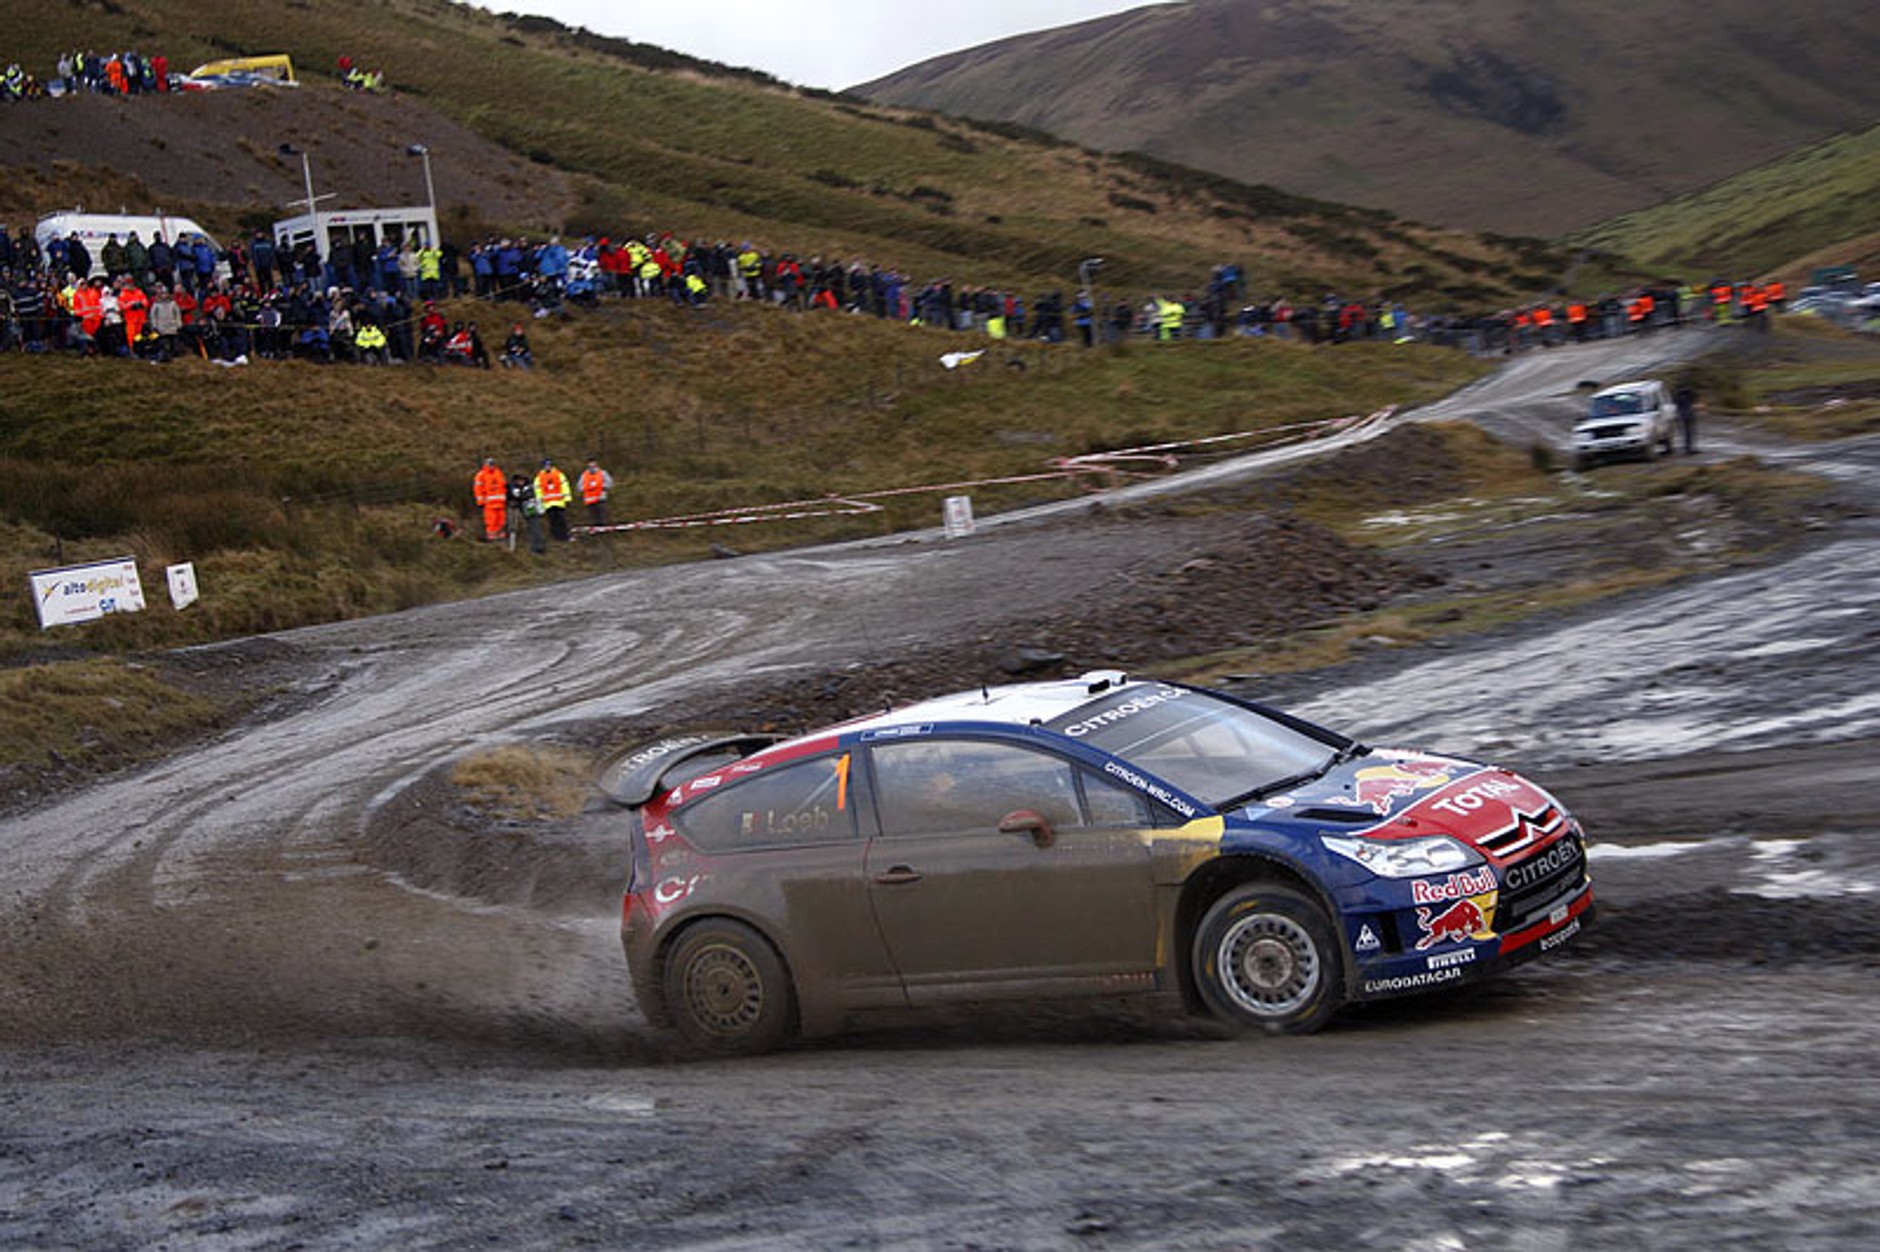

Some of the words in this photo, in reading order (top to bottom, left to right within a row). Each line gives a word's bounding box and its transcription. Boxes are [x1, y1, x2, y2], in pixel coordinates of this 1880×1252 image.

[834, 752, 851, 811] 1
[1431, 779, 1521, 816] TOTAL
[1506, 837, 1579, 889] CITROËN
[1411, 876, 1460, 904] Red
[1457, 865, 1499, 896] Bull
[1427, 947, 1477, 970] PIRELLI
[1364, 968, 1462, 993] EURODATACAR
